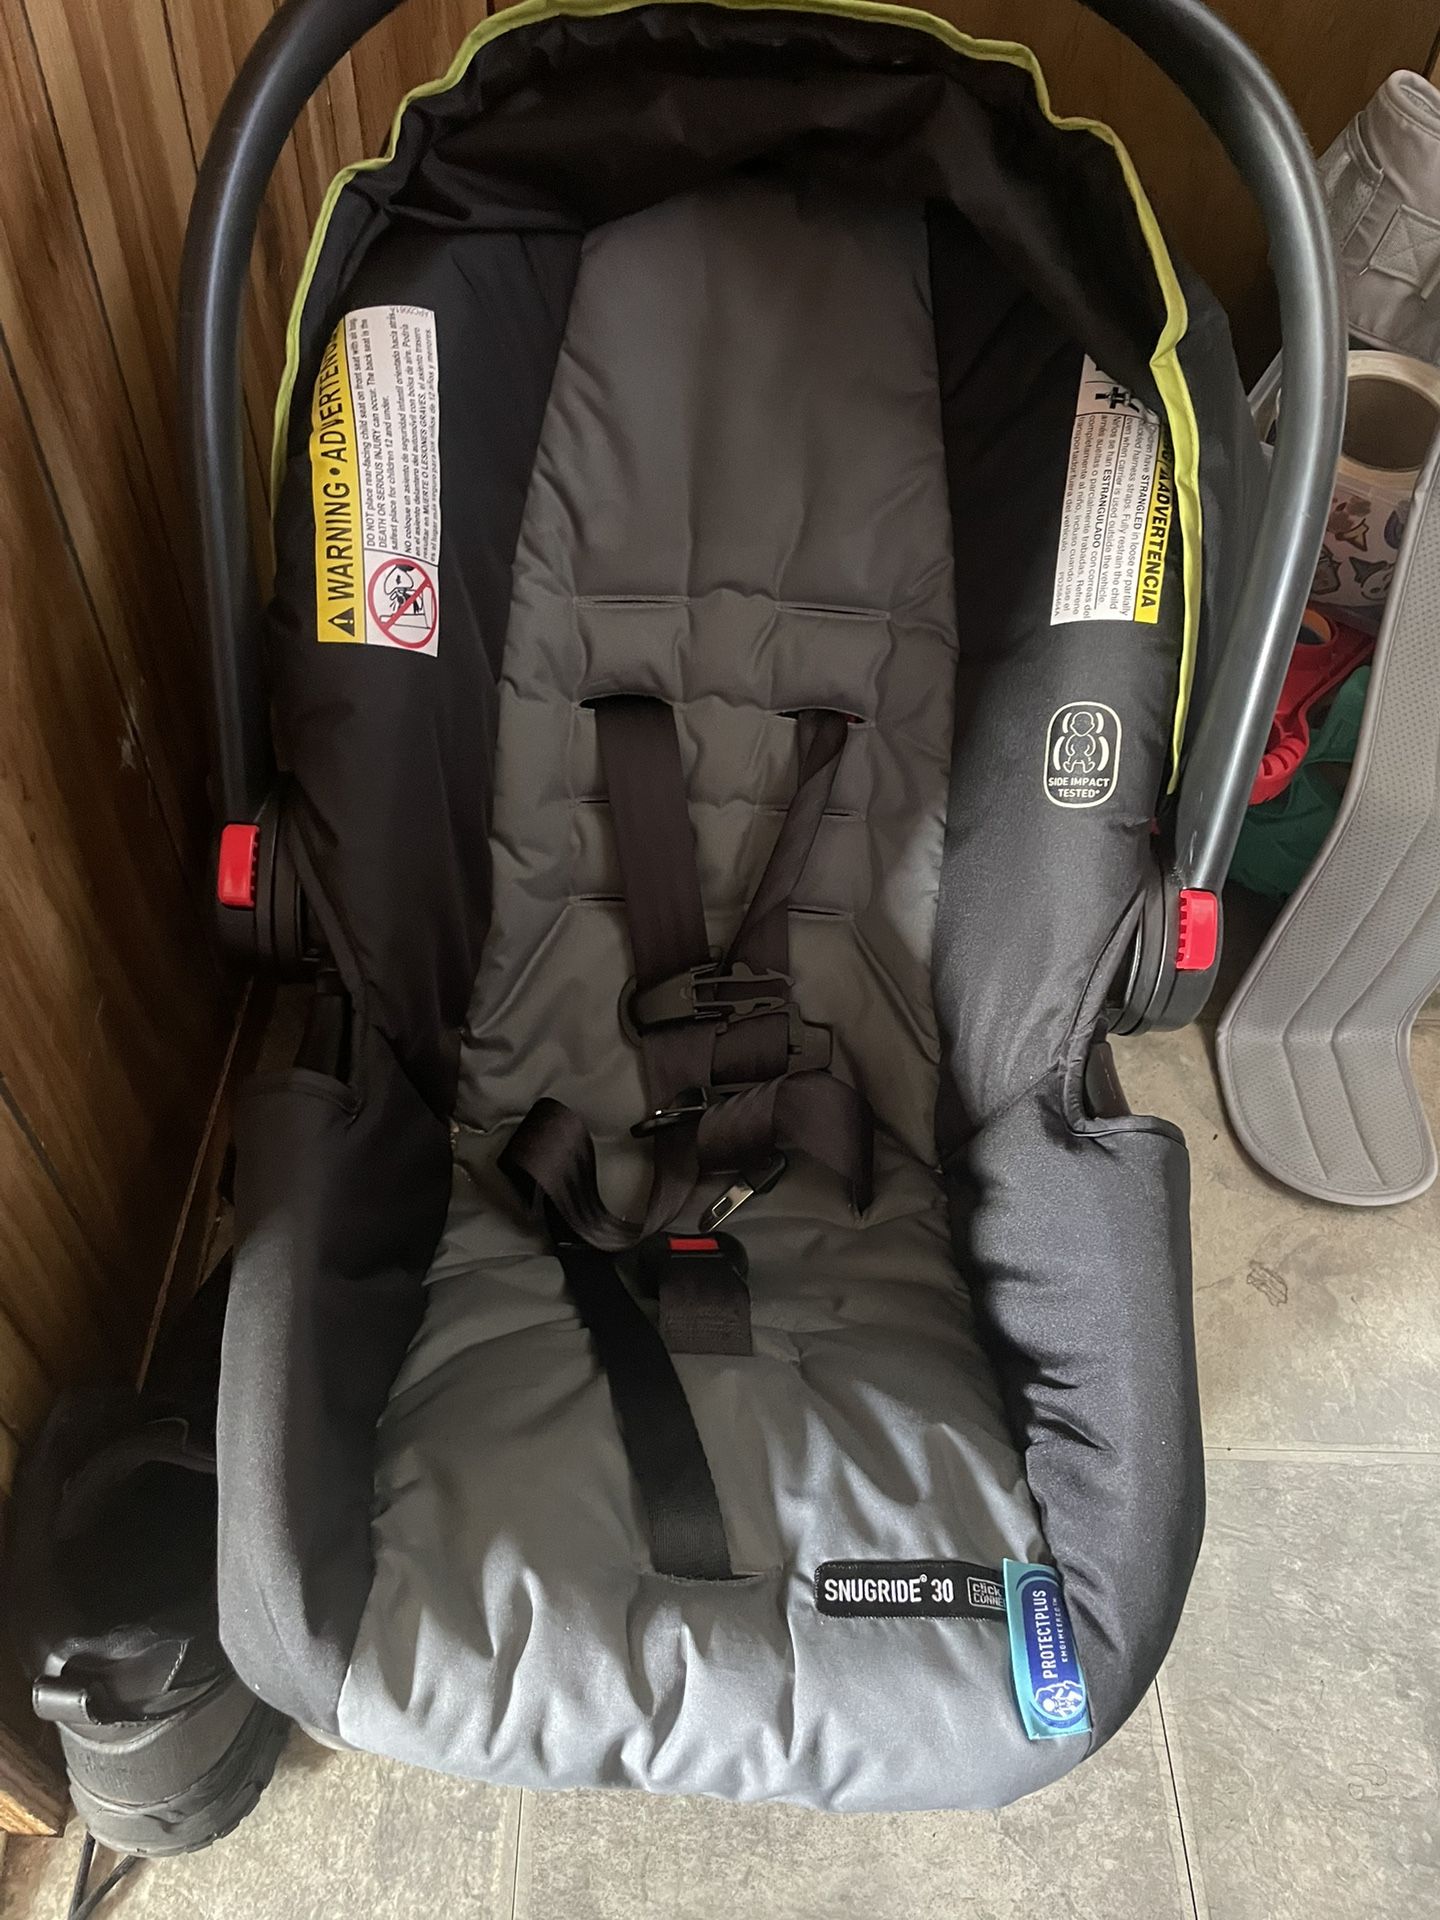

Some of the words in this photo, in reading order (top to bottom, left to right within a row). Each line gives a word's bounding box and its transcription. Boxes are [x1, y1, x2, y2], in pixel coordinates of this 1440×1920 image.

[362, 338, 372, 352] seat
[352, 356, 361, 371] seat
[364, 354, 374, 371] back
[366, 372, 376, 386] The
[319, 328, 349, 462] ADVERTENC
[357, 390, 365, 401] on
[358, 402, 367, 418] seat
[372, 412, 380, 428] can
[359, 420, 370, 440] child
[384, 422, 392, 437] and
[372, 428, 382, 460] INJURY
[384, 438, 394, 448] 12
[1080, 415, 1096, 480] completamente
[1121, 436, 1132, 458] when
[361, 442, 372, 486] rear-facing
[386, 450, 396, 484] children
[1105, 451, 1115, 467] han
[1129, 450, 1142, 481] harness
[1142, 454, 1153, 472] have
[374, 462, 386, 501] SERIOUS
[1116, 460, 1127, 486] carrier
[364, 488, 376, 510] place
[388, 486, 396, 498] for
[1133, 474, 1150, 530] STRANGLED
[377, 503, 386, 516] OR
[388, 500, 399, 523] place
[1082, 478, 1098, 534] parcialmente
[1092, 469, 1112, 548] ESTRANGULADO
[1110, 497, 1120, 518] used
[365, 512, 375, 532] NOT
[1118, 514, 1130, 534] Fully
[322, 482, 354, 600] WARNING
[366, 533, 376, 546] DO
[378, 518, 388, 548] DEATH
[390, 524, 398, 550] safest
[1106, 520, 1116, 552] outside
[1131, 532, 1141, 540] in
[404, 540, 412, 554] NO
[1114, 536, 1126, 569] restrain
[1127, 542, 1140, 566] loose
[1140, 482, 1170, 608] ADVERTENCIA
[1090, 550, 1098, 568] con
[1102, 554, 1112, 569] the
[1112, 571, 1123, 586] the
[1126, 569, 1134, 578] or
[1085, 568, 1096, 603] correas
[1110, 588, 1118, 610] child
[1120, 580, 1134, 616] partially
[1048, 777, 1069, 787] SIDE
[1070, 777, 1111, 788] IMPACT
[930, 1578, 954, 1603] 30
[973, 1592, 1006, 1608] CONNE
[1032, 1590, 1059, 1679] PROTECTPLUS
